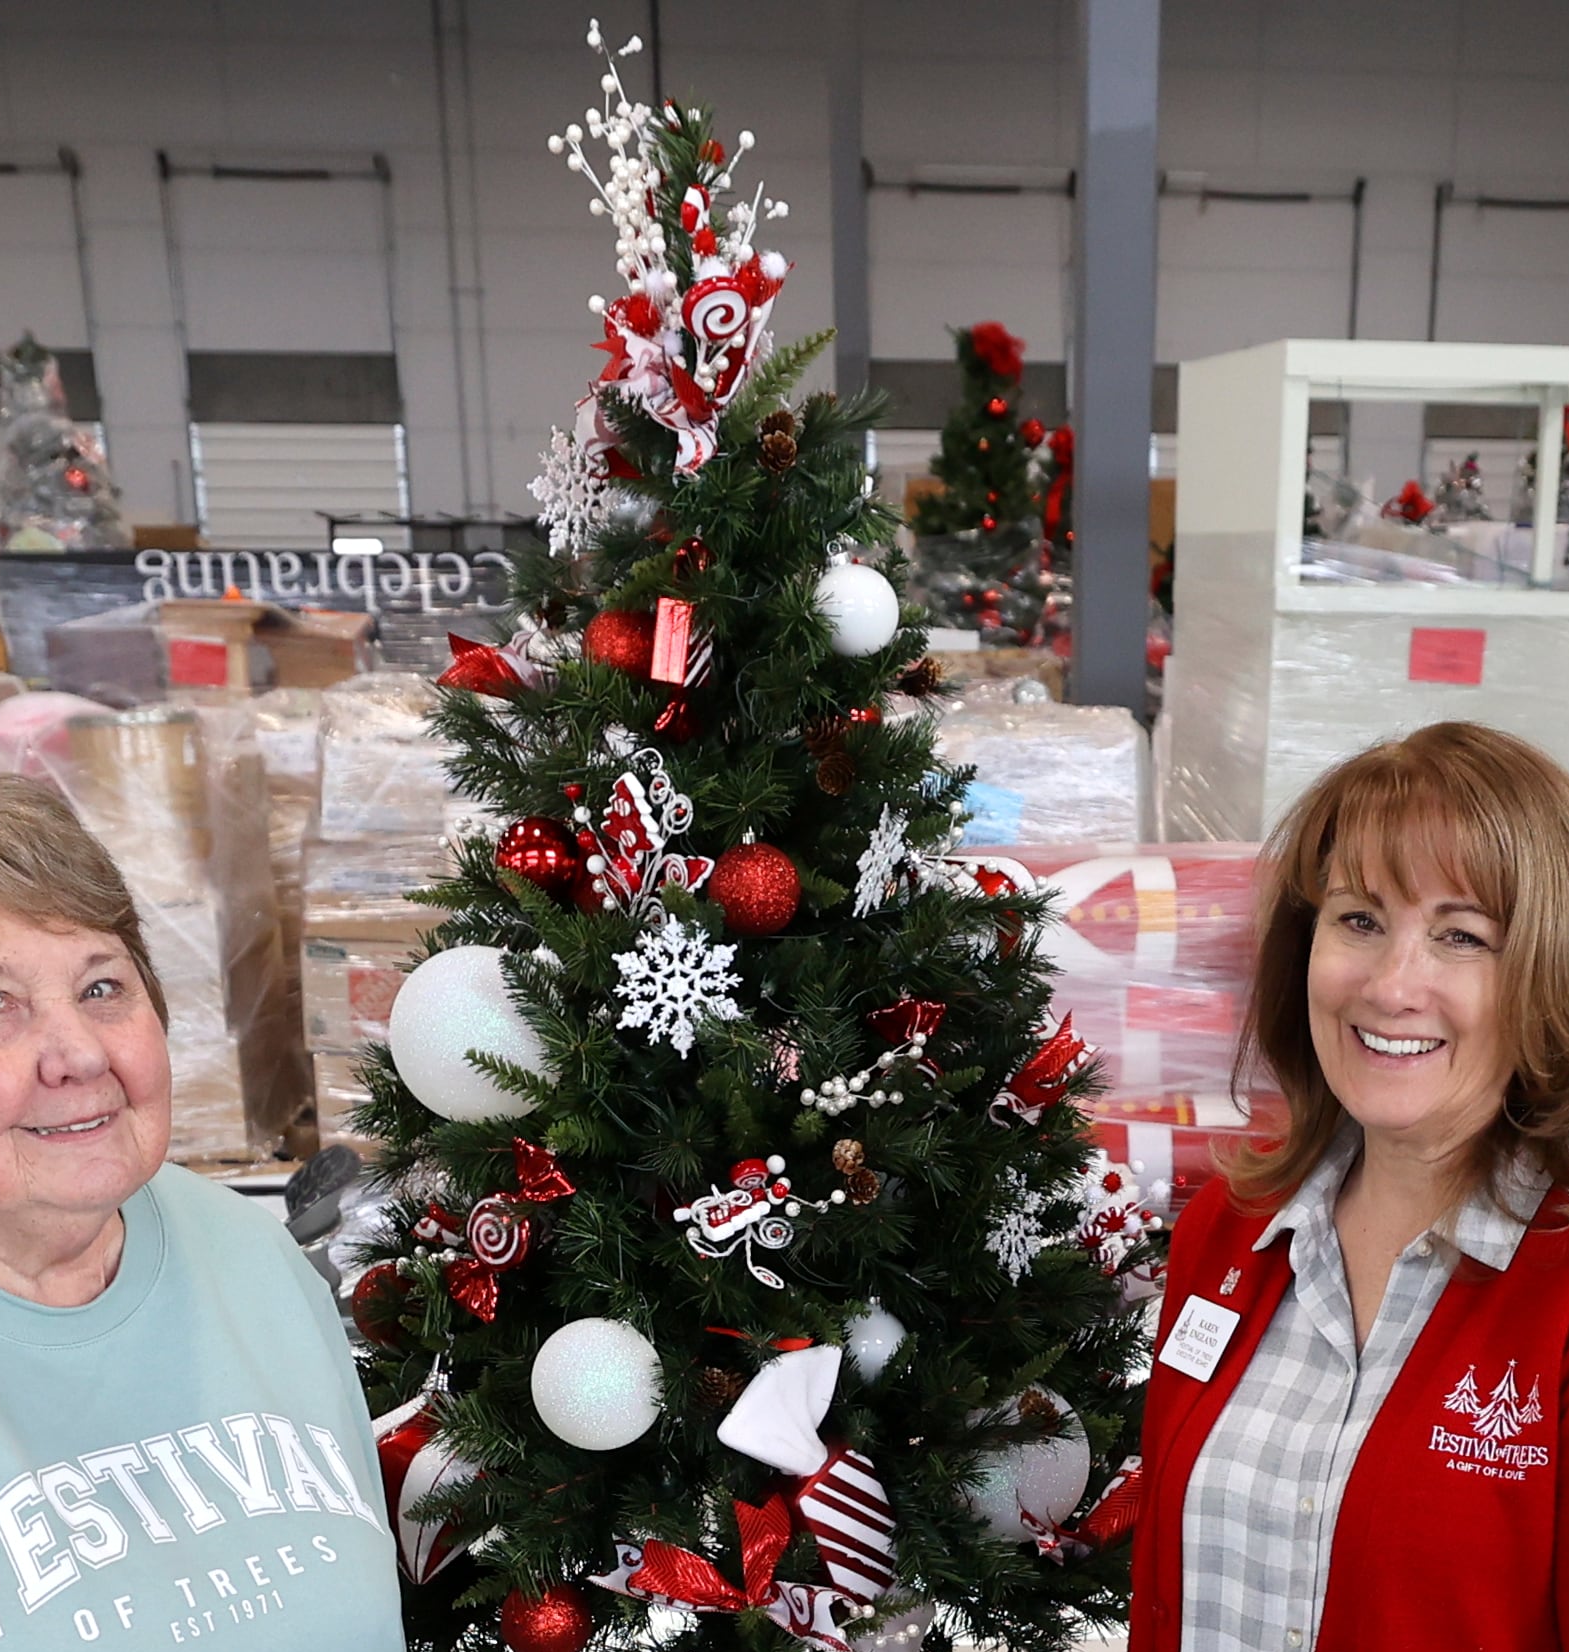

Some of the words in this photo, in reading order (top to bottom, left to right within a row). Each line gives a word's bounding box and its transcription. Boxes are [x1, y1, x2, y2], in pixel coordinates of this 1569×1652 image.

[1189, 1329, 1218, 1348] ENGLAND
[1199, 1319, 1220, 1334] KAREN
[1428, 1425, 1497, 1462] FESTIVAL
[1505, 1445, 1549, 1469] TREES
[1446, 1459, 1455, 1470] A
[1456, 1461, 1481, 1475] GIFT
[1482, 1466, 1498, 1478] OF
[1499, 1468, 1526, 1481] LOVE
[74, 1595, 135, 1642] OF
[175, 1535, 338, 1609] TREES
[170, 1609, 216, 1644] EST
[228, 1590, 285, 1626] 1971
